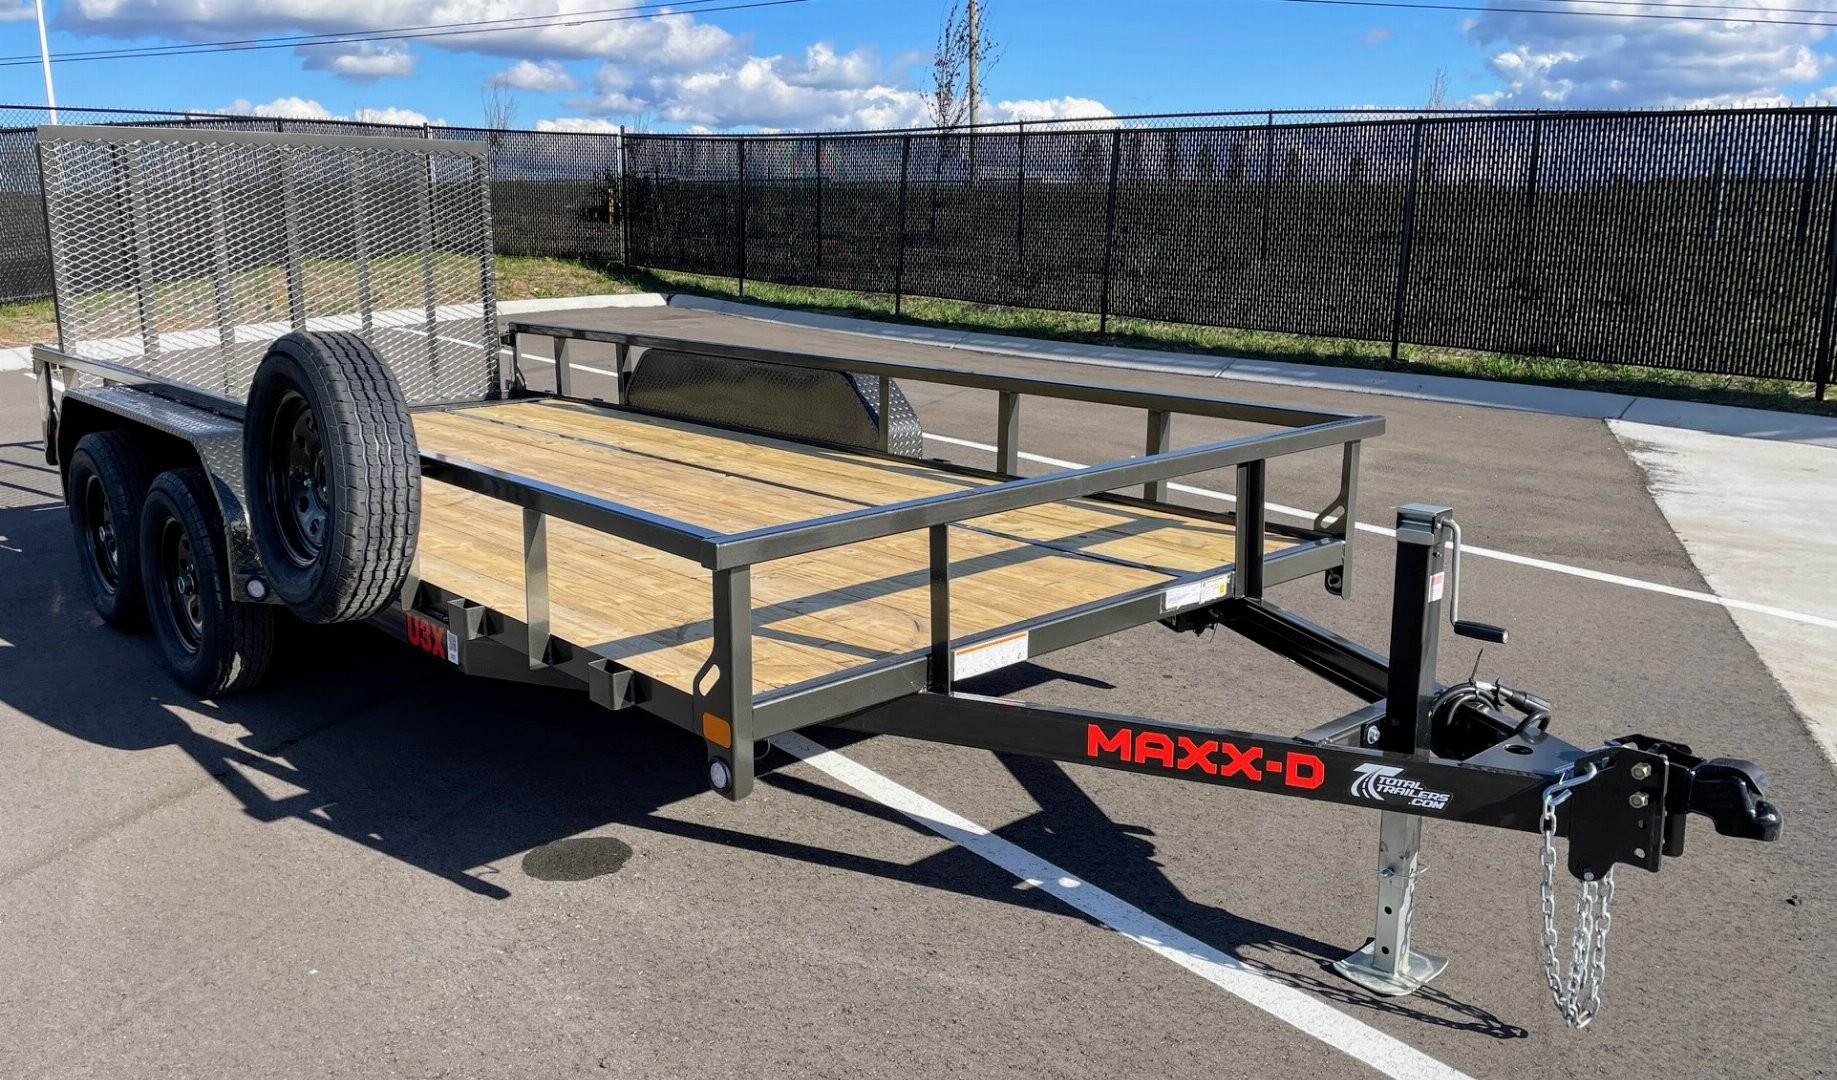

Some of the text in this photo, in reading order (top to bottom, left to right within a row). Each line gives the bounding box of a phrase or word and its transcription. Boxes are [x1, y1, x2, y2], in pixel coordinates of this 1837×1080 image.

[407, 611, 446, 660] U3X
[1087, 723, 1325, 790] MAXX-D
[1376, 783, 1450, 802] TRAILERS
[1378, 776, 1424, 790] TOTAL
[1408, 797, 1445, 810] .COM
